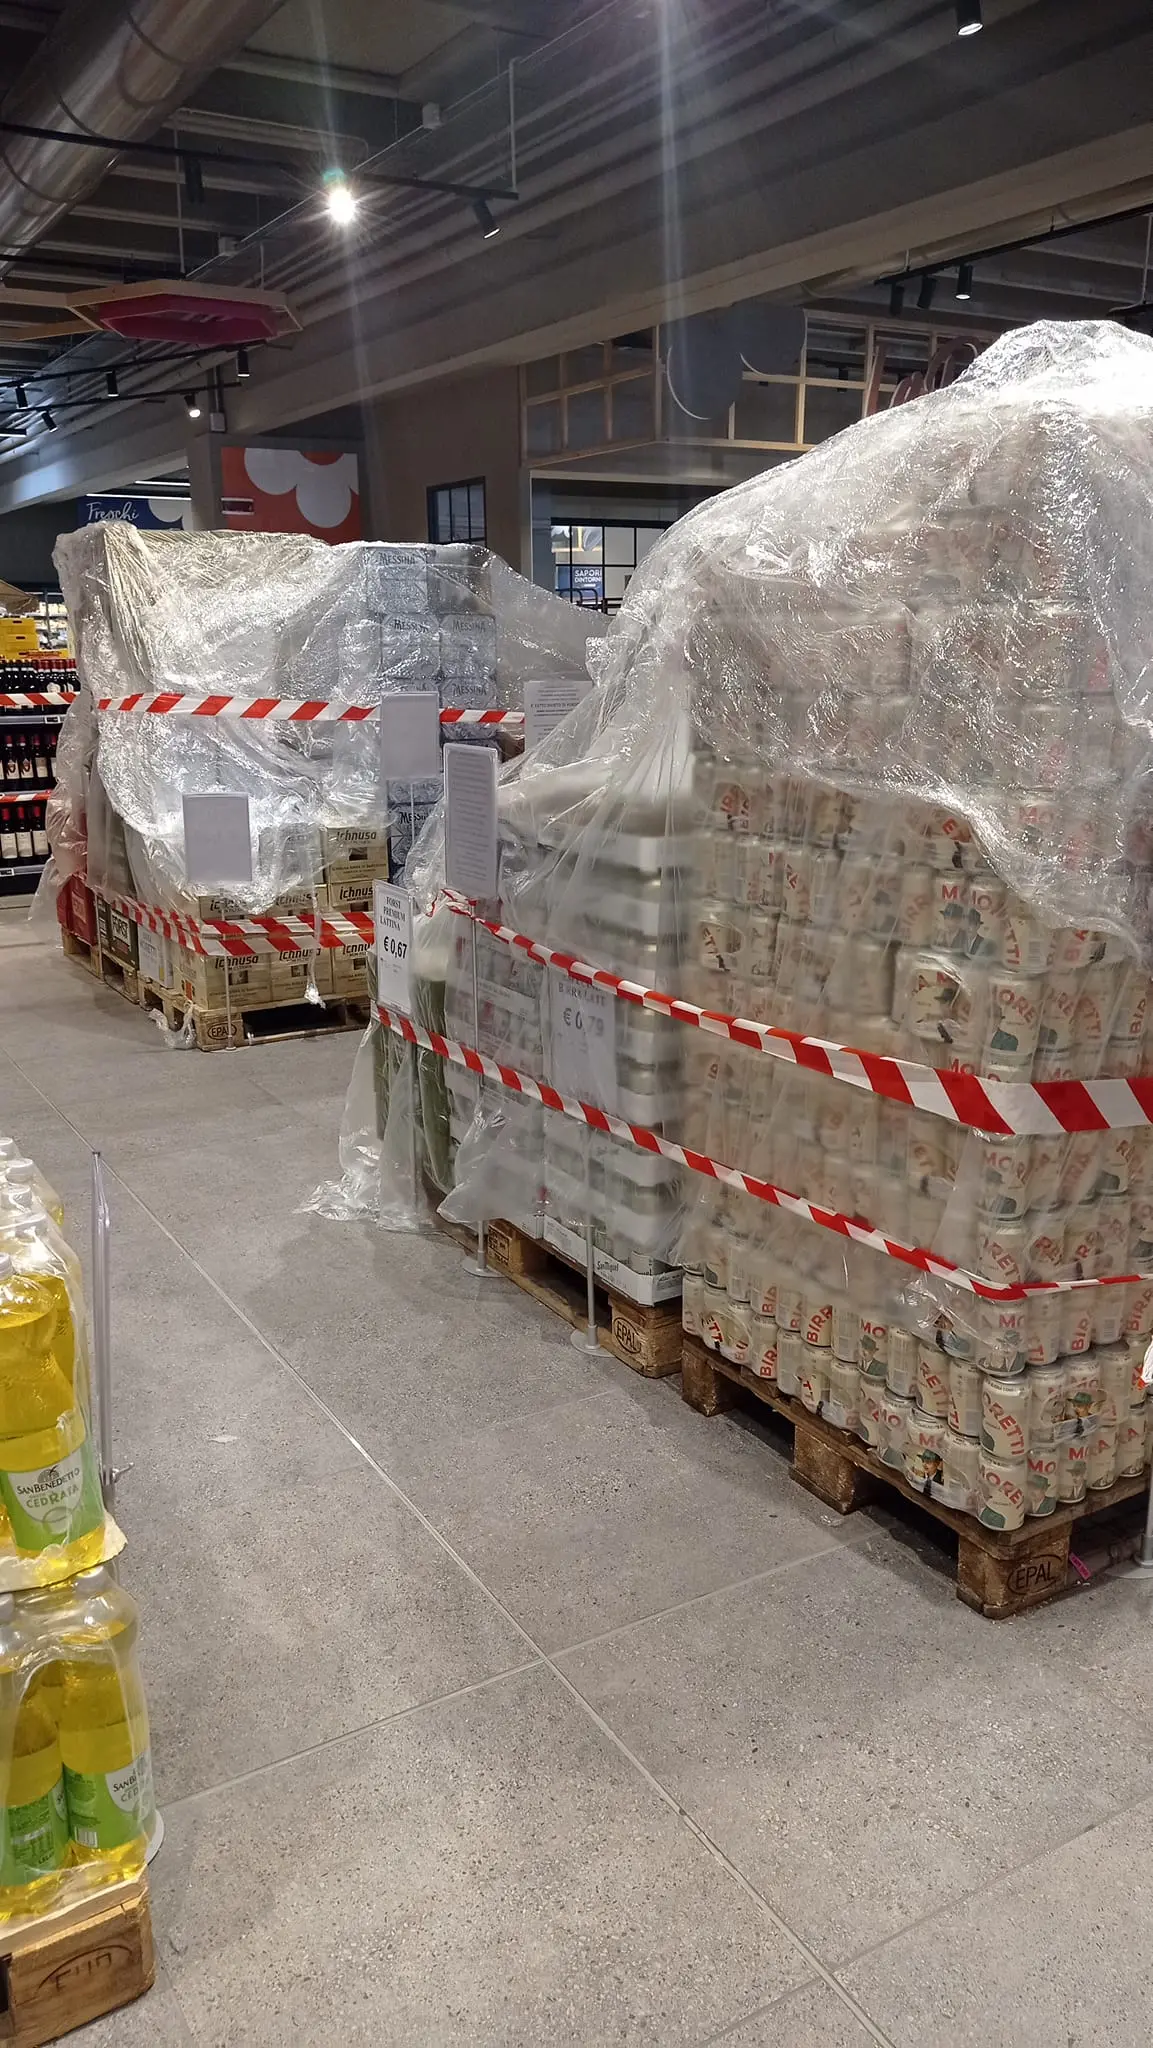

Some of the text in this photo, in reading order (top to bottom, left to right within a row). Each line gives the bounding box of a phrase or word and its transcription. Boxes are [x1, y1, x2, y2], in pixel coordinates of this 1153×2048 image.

[86, 501, 139, 521] Freschi
[390, 938, 408, 959] 0,67
[616, 1321, 638, 1351] EPAL
[26, 1484, 79, 1509] CEDRATA
[1015, 1561, 1057, 1590] EPAL
